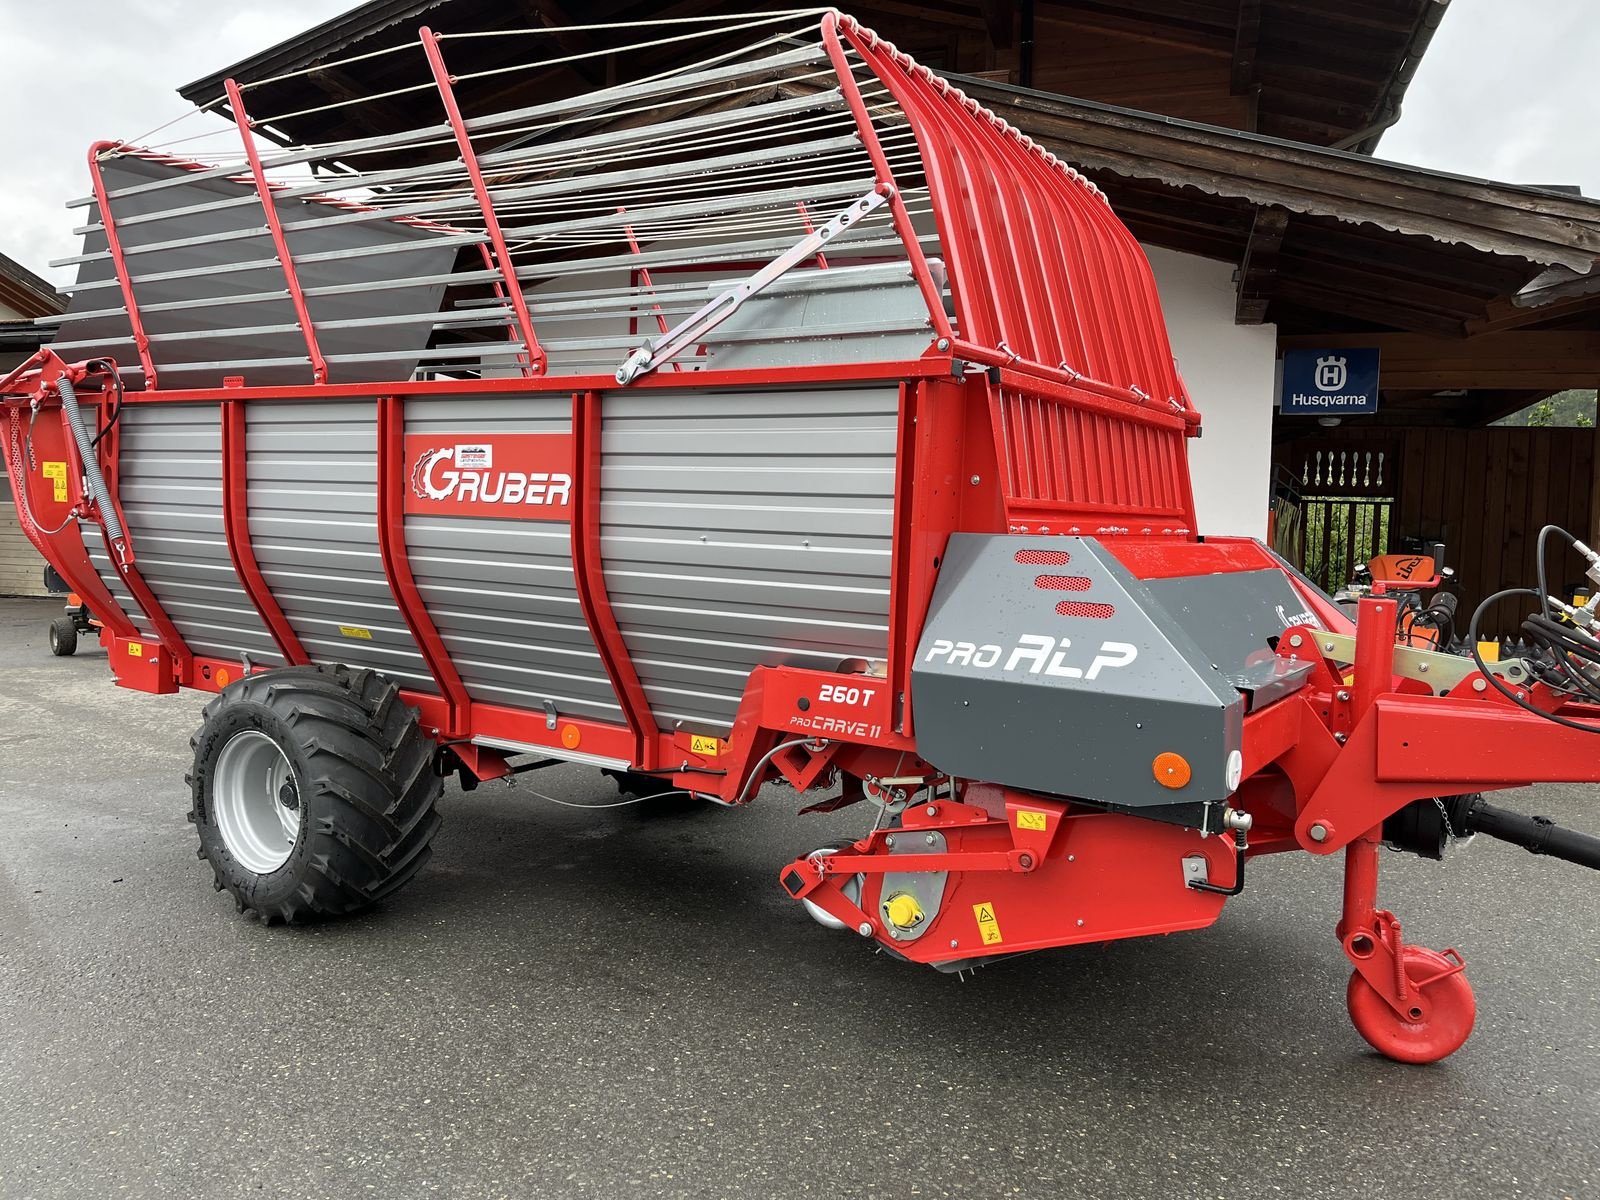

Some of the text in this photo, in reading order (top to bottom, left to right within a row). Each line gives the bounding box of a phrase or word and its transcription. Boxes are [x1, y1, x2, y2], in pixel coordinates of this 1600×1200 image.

[1292, 393, 1367, 407] Husqvarna
[421, 448, 572, 506] GRUBER
[924, 633, 1138, 680] PRO ALP
[789, 716, 811, 727] PRO
[812, 716, 868, 737] CARVE
